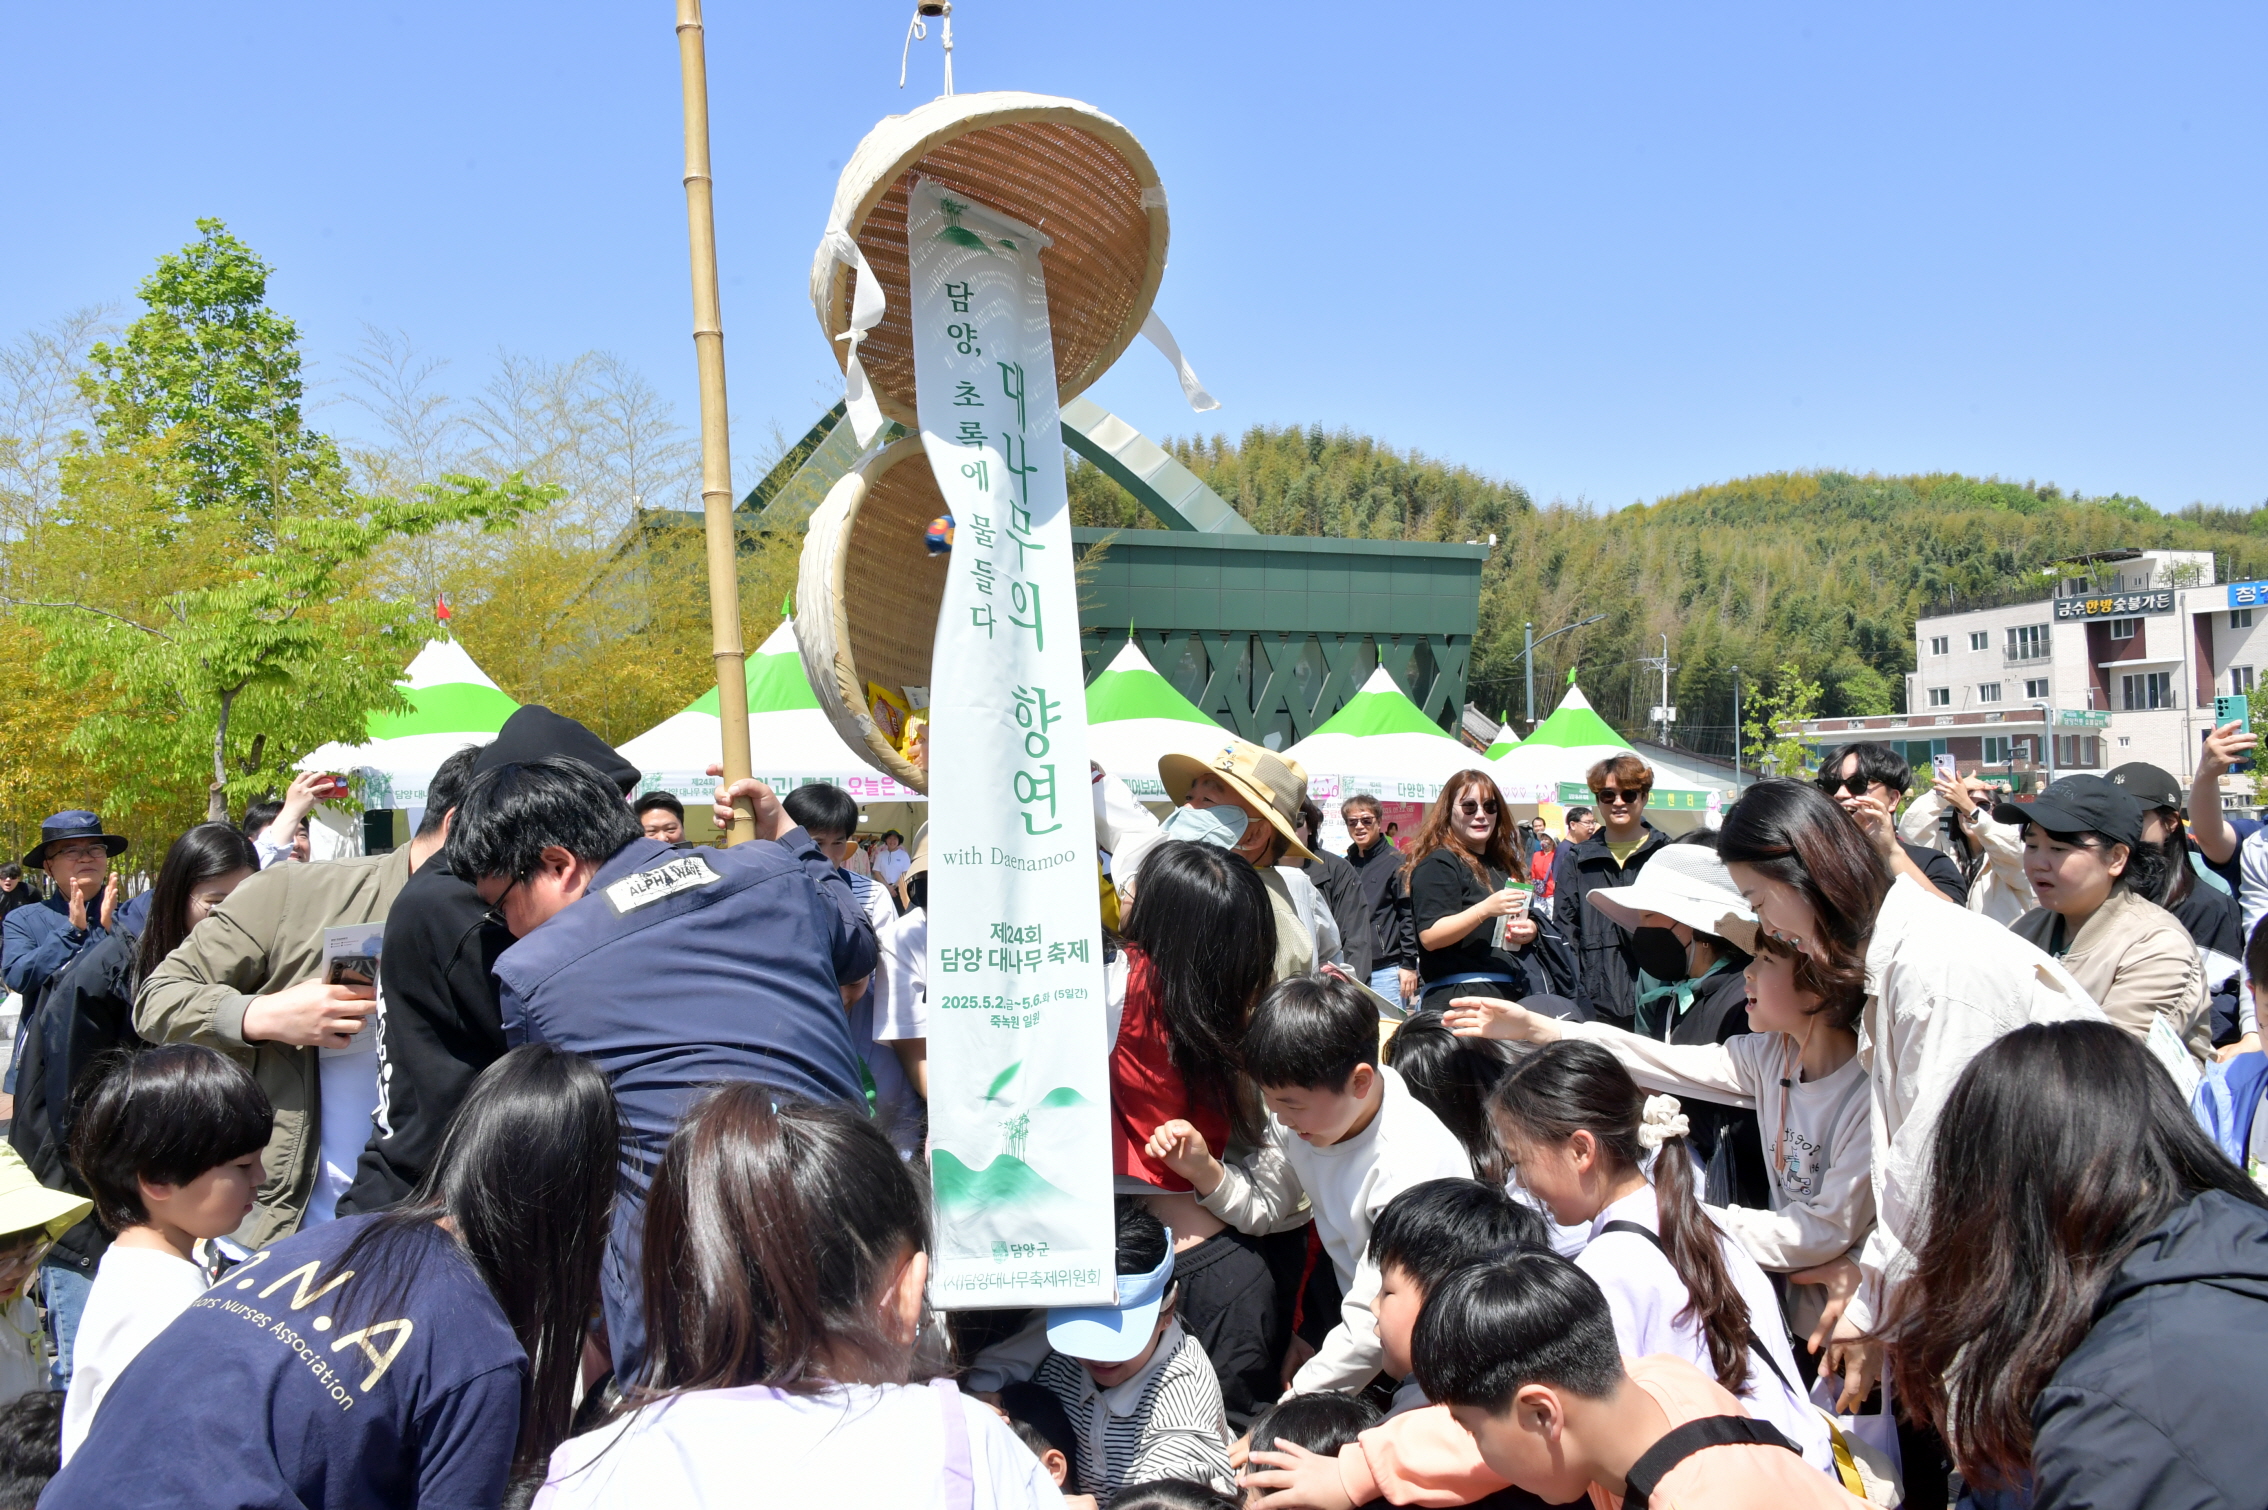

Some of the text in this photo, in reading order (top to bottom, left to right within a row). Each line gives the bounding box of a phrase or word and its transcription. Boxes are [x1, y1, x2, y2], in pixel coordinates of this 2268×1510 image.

[945, 281, 997, 640] 담양, 초록에 물들다
[997, 361, 1063, 835] 대나무의 향연
[848, 776, 896, 797] 오늘은
[1397, 783, 1425, 798] 다양한
[943, 846, 1076, 872] with Daenamoo
[630, 868, 675, 897] ALPHA
[990, 922, 1042, 945] 제24회
[940, 938, 1090, 975] 담양 대나무 축제
[1053, 988, 1088, 1001] (5일간)
[990, 1010, 1040, 1029] 죽녹원 일원
[1010, 1241, 1050, 1259] 담양군
[220, 1299, 273, 1328] Nurses
[269, 1321, 354, 1411] Association
